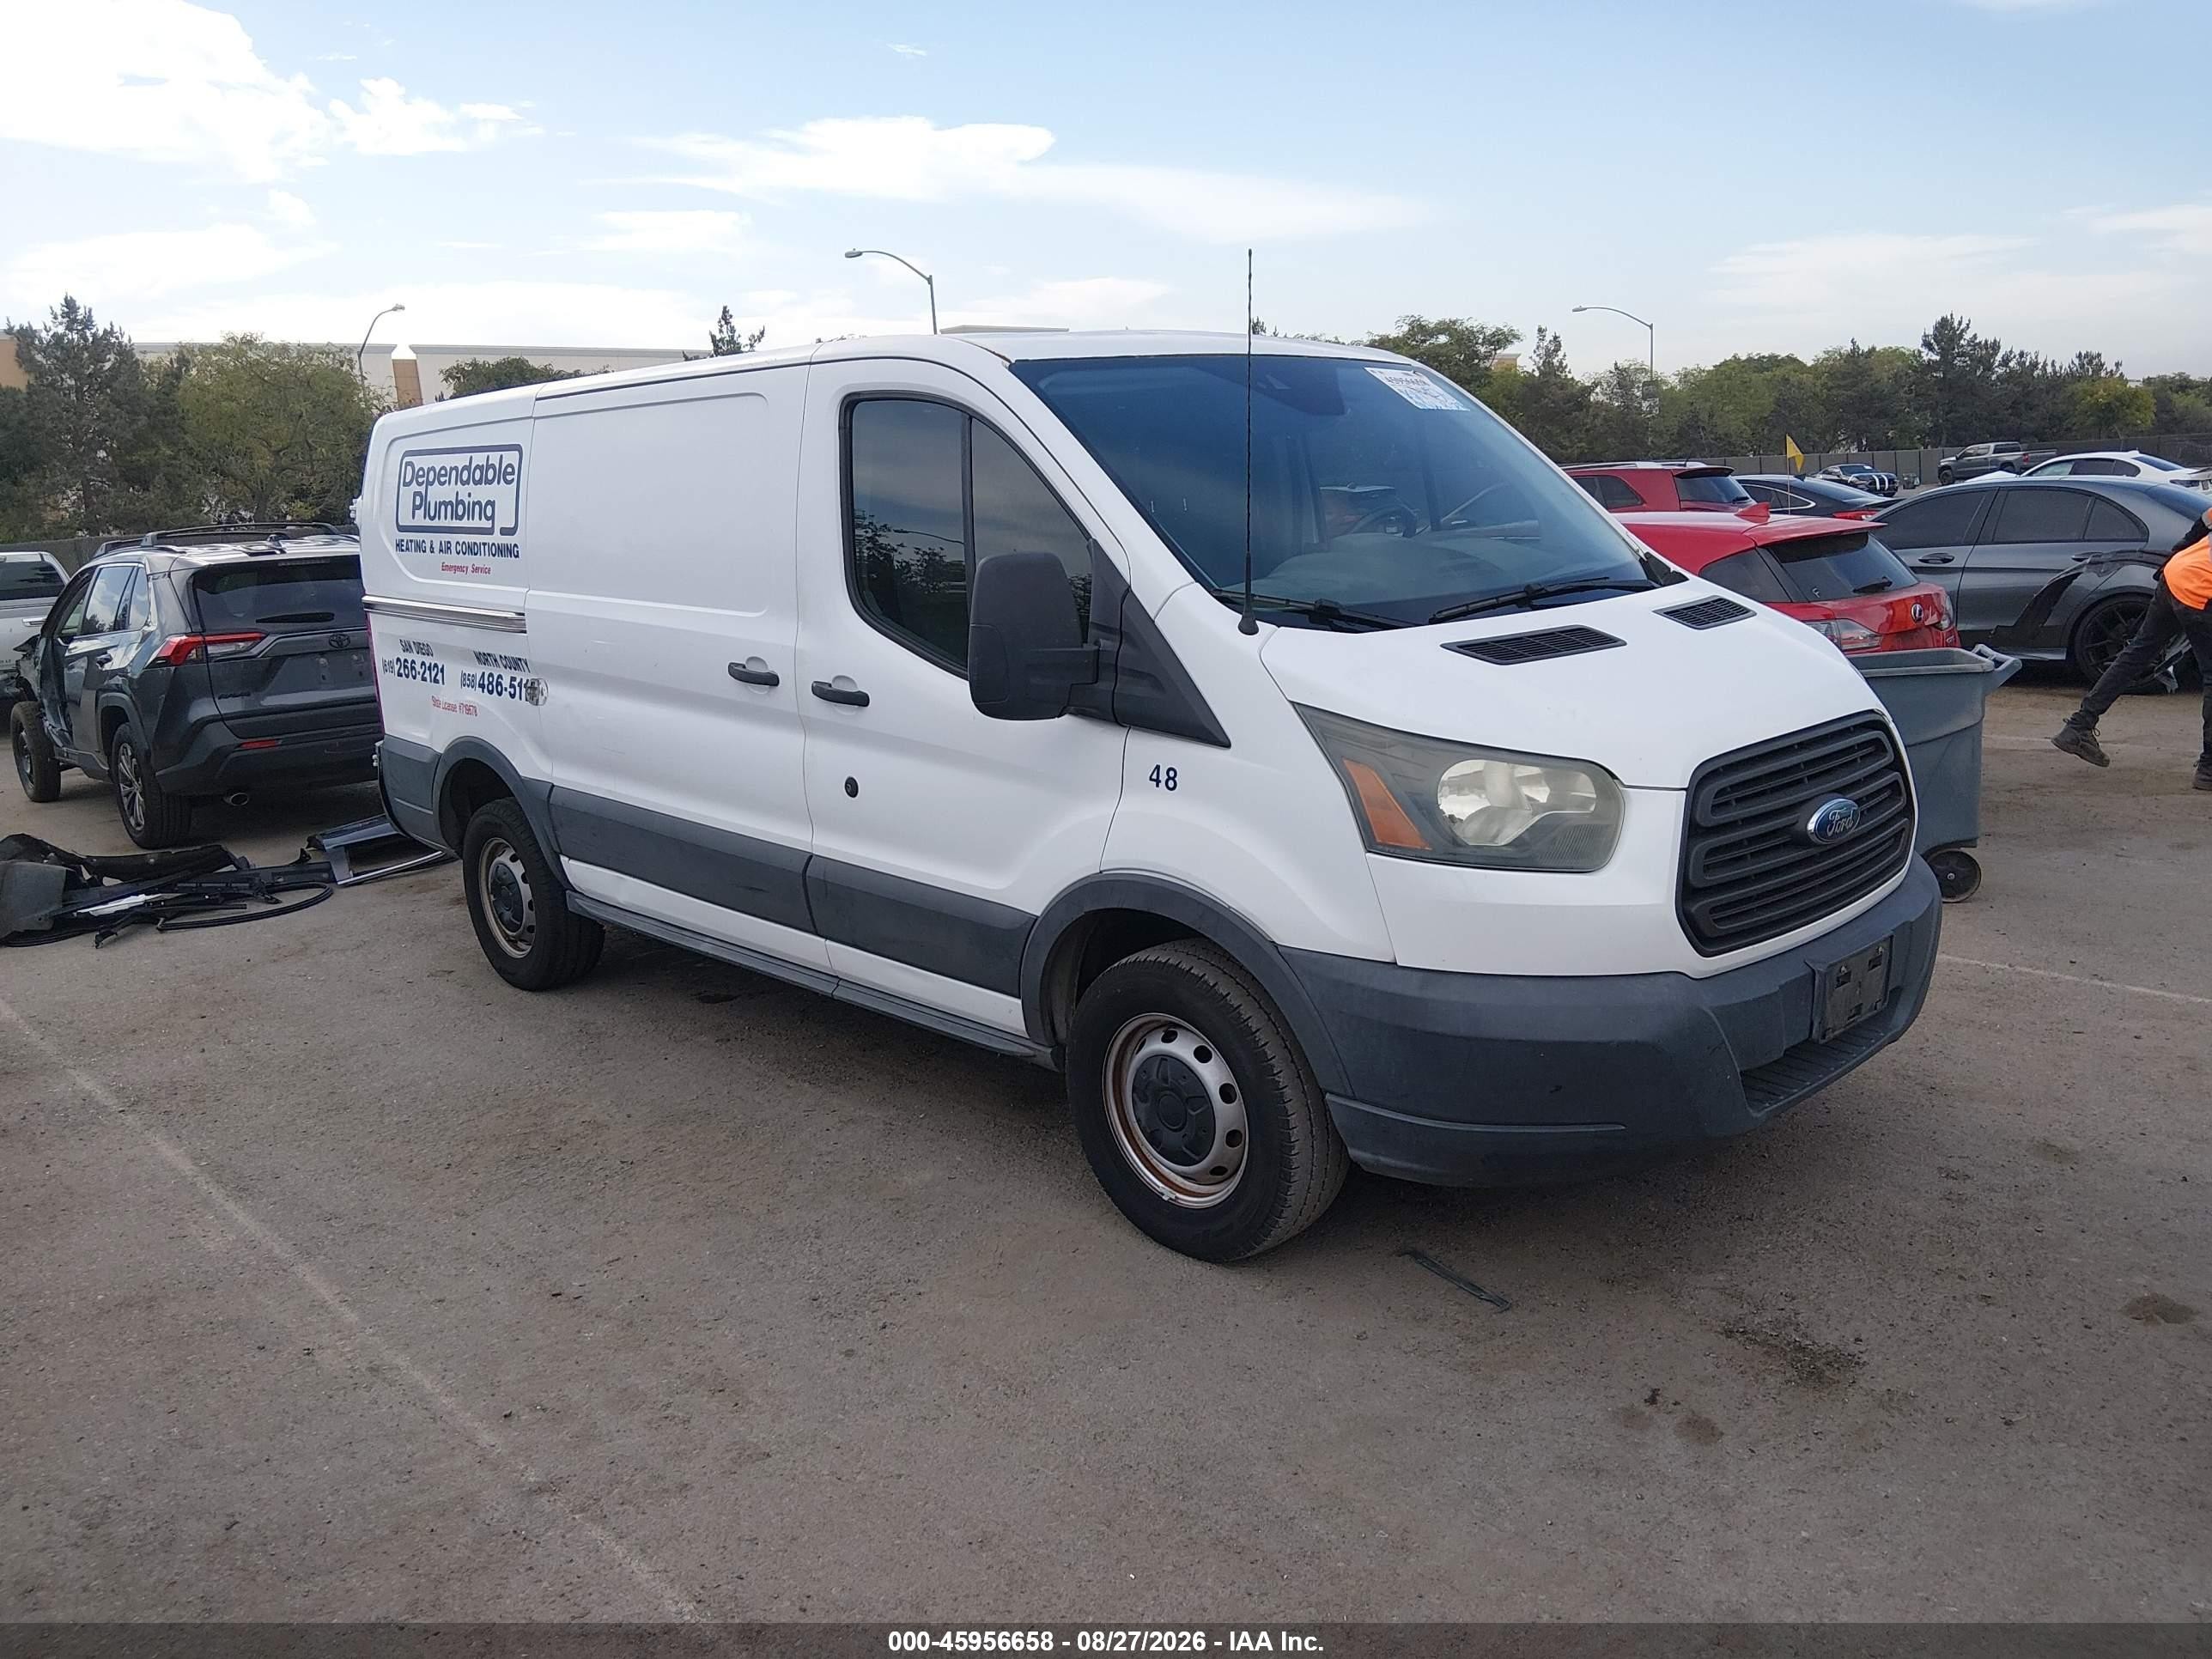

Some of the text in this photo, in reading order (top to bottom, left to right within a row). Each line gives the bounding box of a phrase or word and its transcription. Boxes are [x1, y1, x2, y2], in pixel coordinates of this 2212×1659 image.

[402, 454, 516, 488] Dependable
[411, 489, 495, 526] Plumbing
[395, 538, 520, 558] HEATING & AIR CONDITIONING
[441, 562, 491, 574] Emergency Service
[399, 639, 434, 657] SAN DIEGO
[382, 657, 446, 685] (619) 266-2121
[473, 650, 532, 673] NORTH COUNTY
[460, 670, 477, 691] (858)
[1149, 763, 1178, 792] 48
[1826, 807, 1853, 837] Ford
